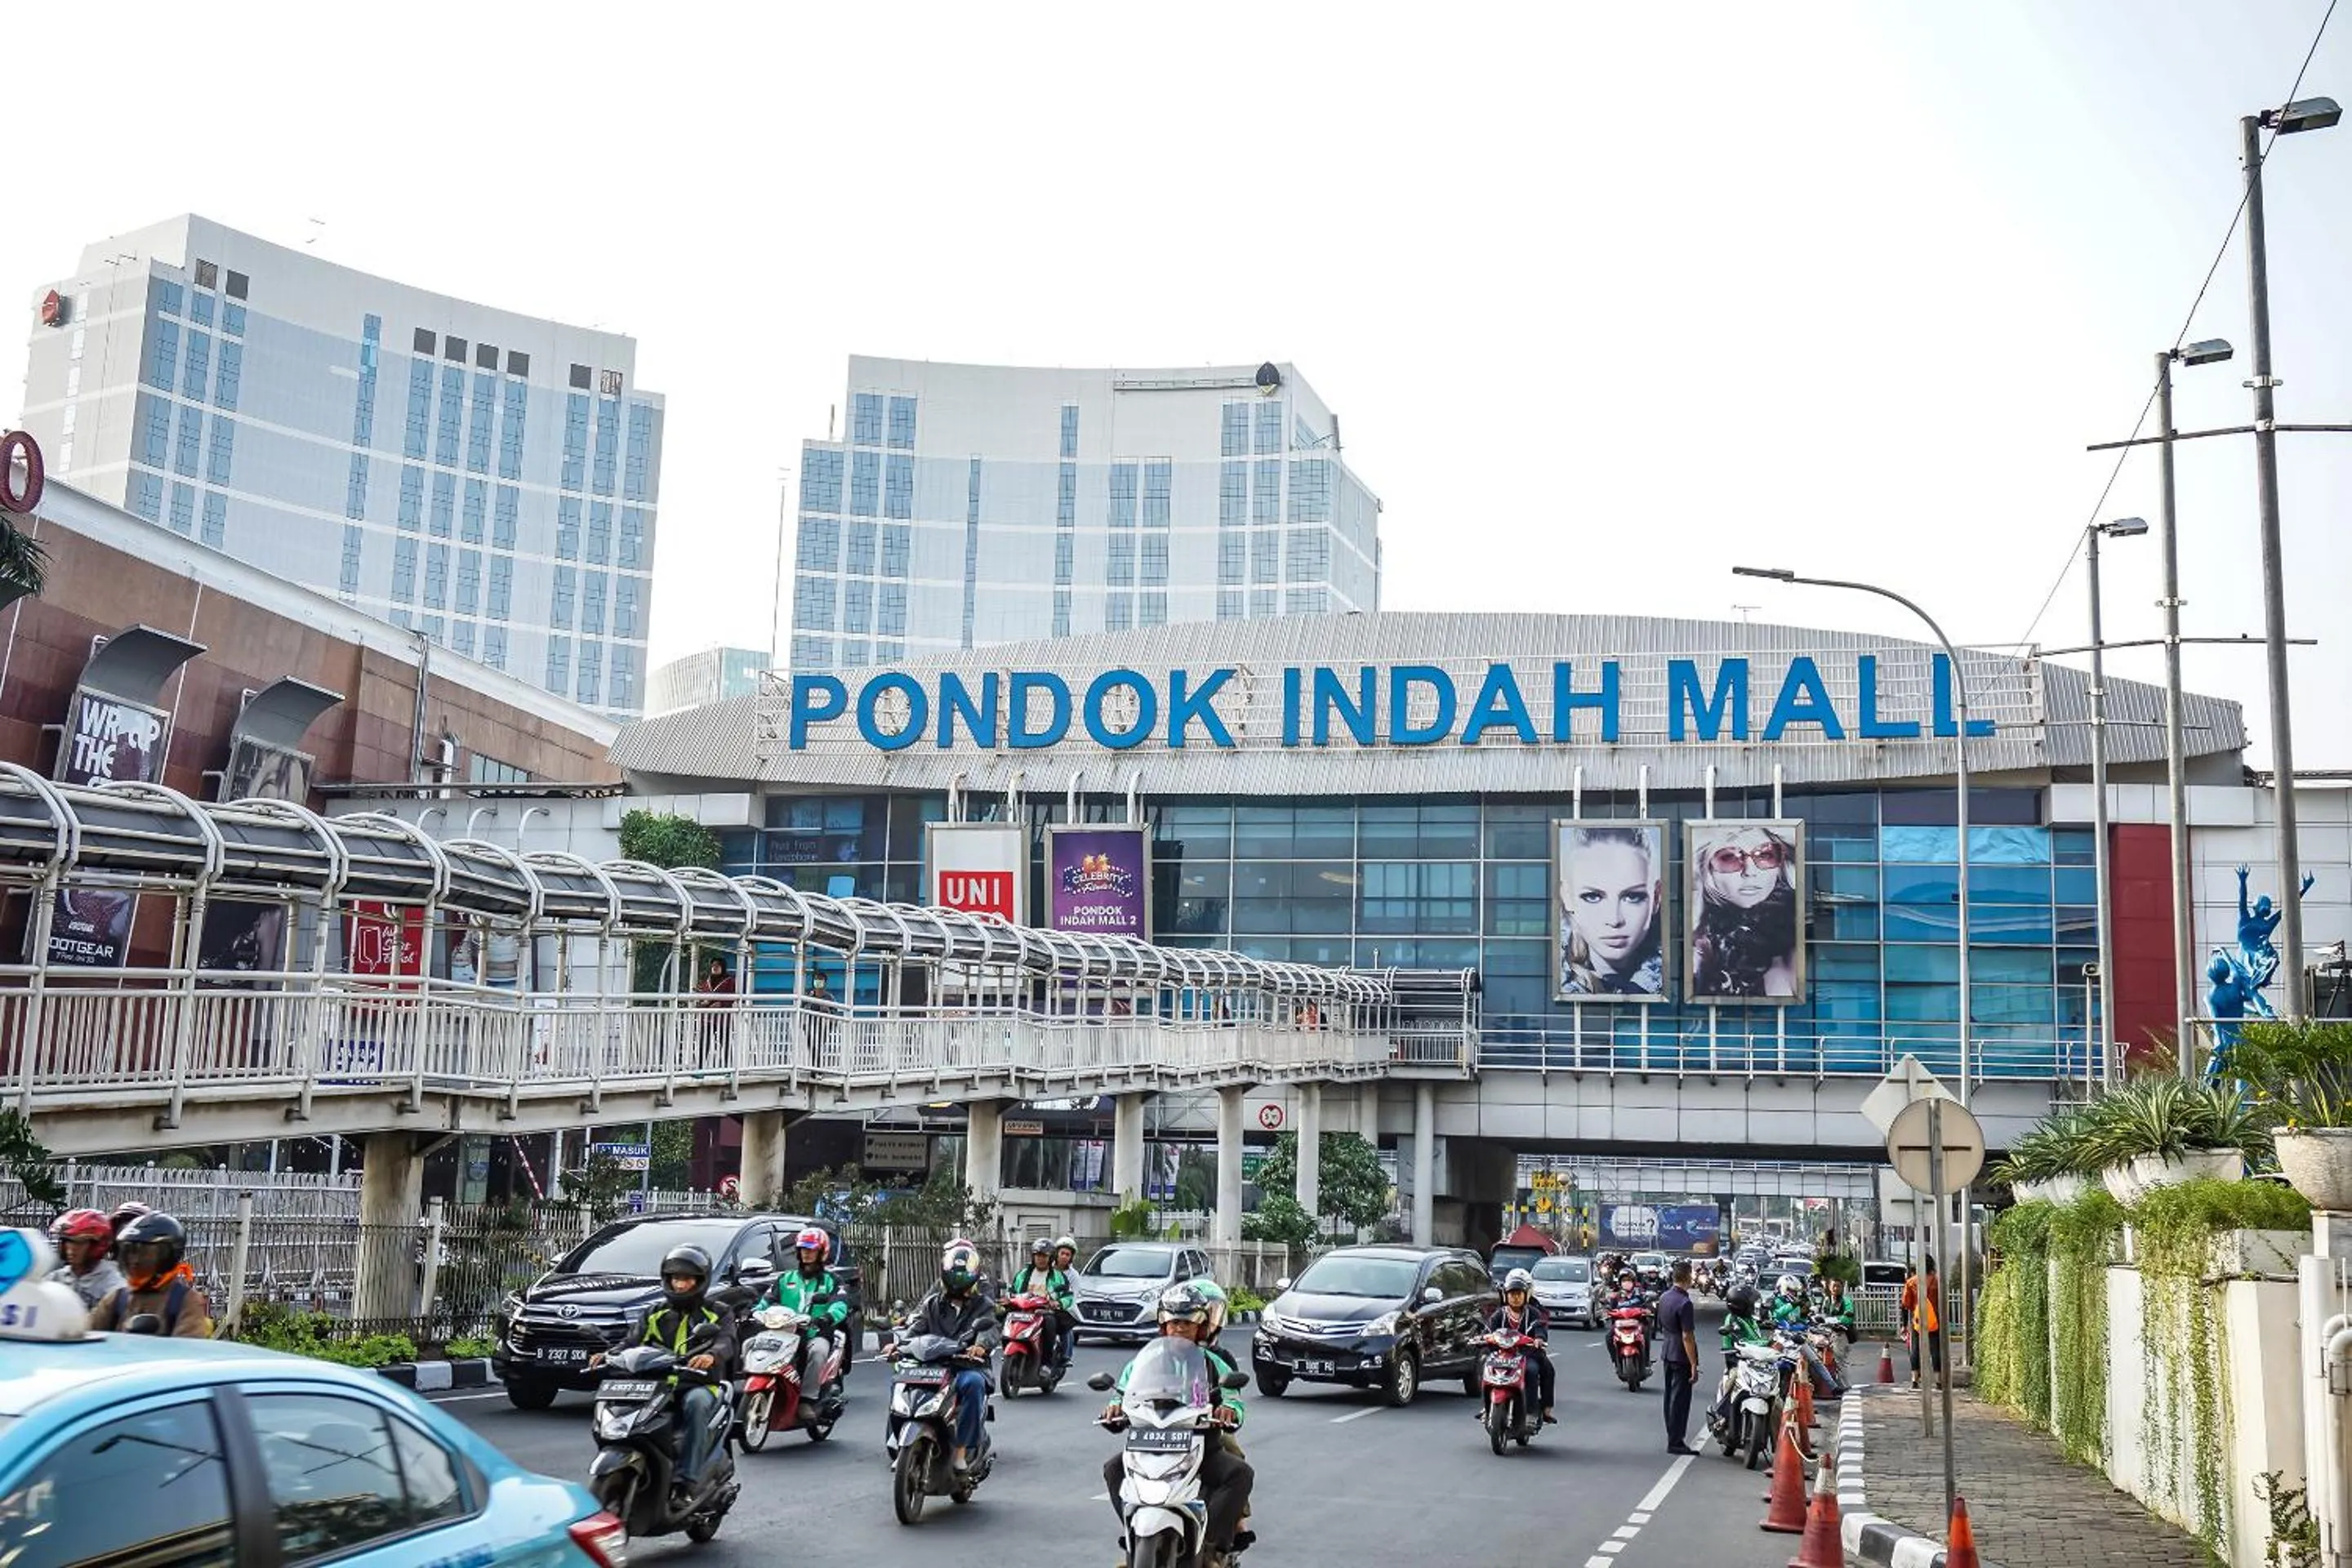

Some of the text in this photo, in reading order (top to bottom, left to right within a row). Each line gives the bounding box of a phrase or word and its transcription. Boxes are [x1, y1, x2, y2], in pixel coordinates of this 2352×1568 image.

[790, 653, 1994, 751] PONDOK INDAH MALL
[74, 733, 117, 778] THE
[1072, 871, 1124, 884] CELEBRITY
[947, 877, 1000, 906] UNI
[1073, 906, 1123, 915] PONDOK
[1060, 915, 1137, 926] INDAH MALL 2
[49, 937, 114, 958] OOTGEAR
[612, 1146, 648, 1156] MASUK
